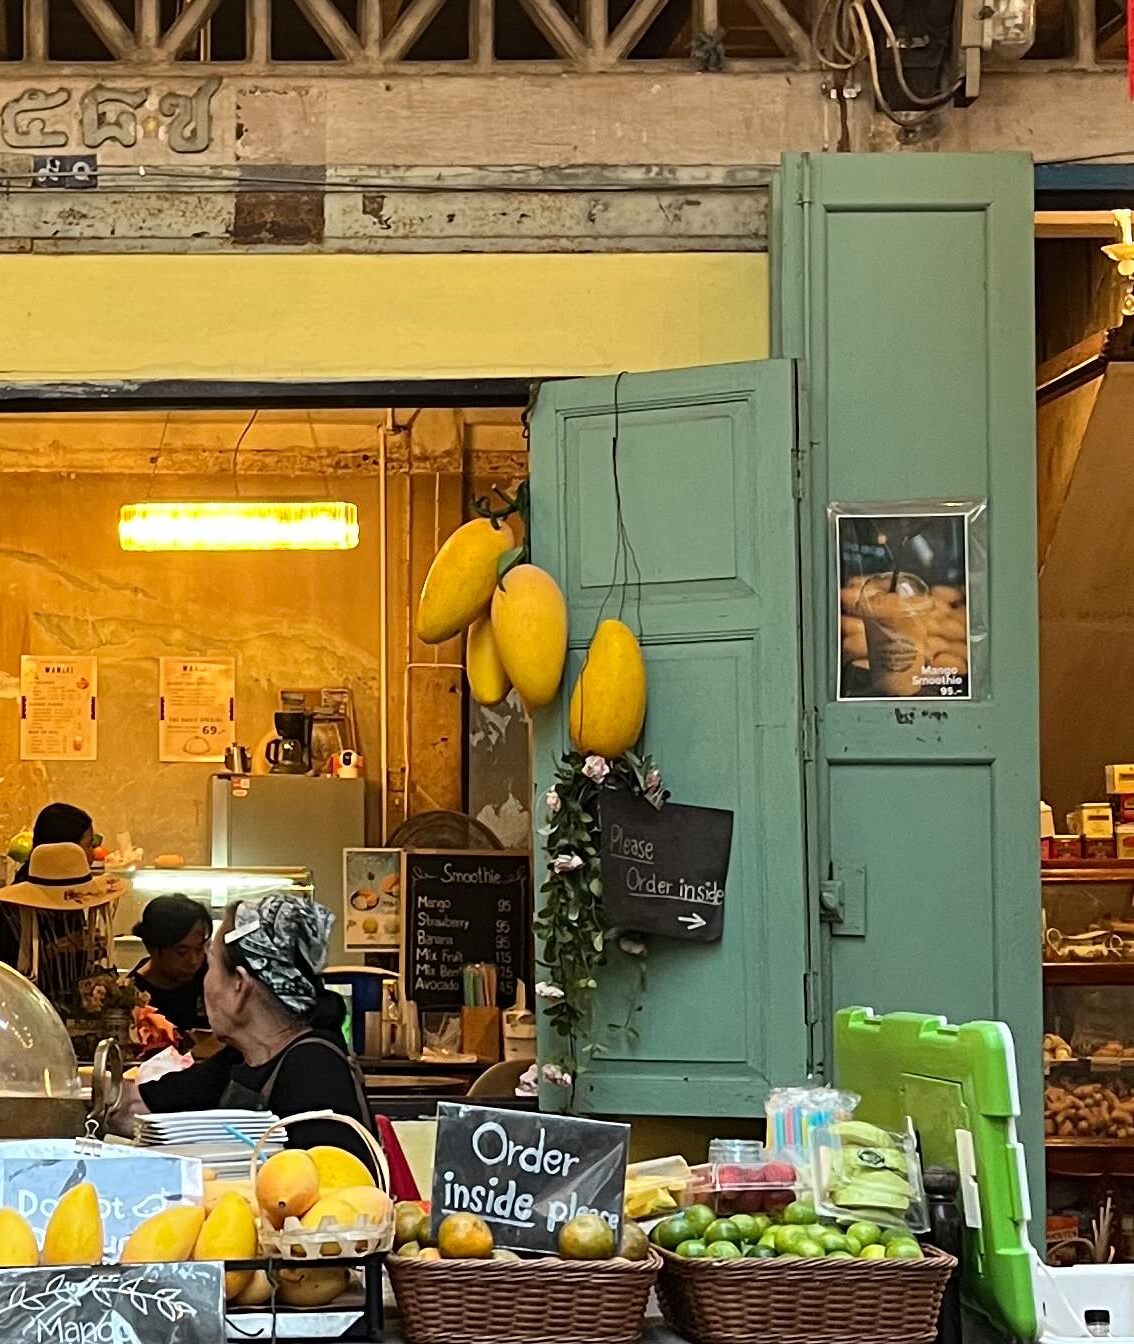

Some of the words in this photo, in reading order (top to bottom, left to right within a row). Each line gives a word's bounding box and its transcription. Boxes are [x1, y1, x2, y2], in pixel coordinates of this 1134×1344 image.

[609, 824, 655, 860] Please
[440, 862, 501, 884] Smoothie
[626, 866, 673, 894] Order
[679, 877, 724, 902] inside
[417, 895, 451, 913] Mango
[417, 929, 454, 945] Banana
[416, 947, 437, 961] Mix
[416, 963, 436, 976] Mix
[414, 977, 460, 990] Avocado
[471, 1121, 581, 1177] Order
[443, 1171, 535, 1222] inside
